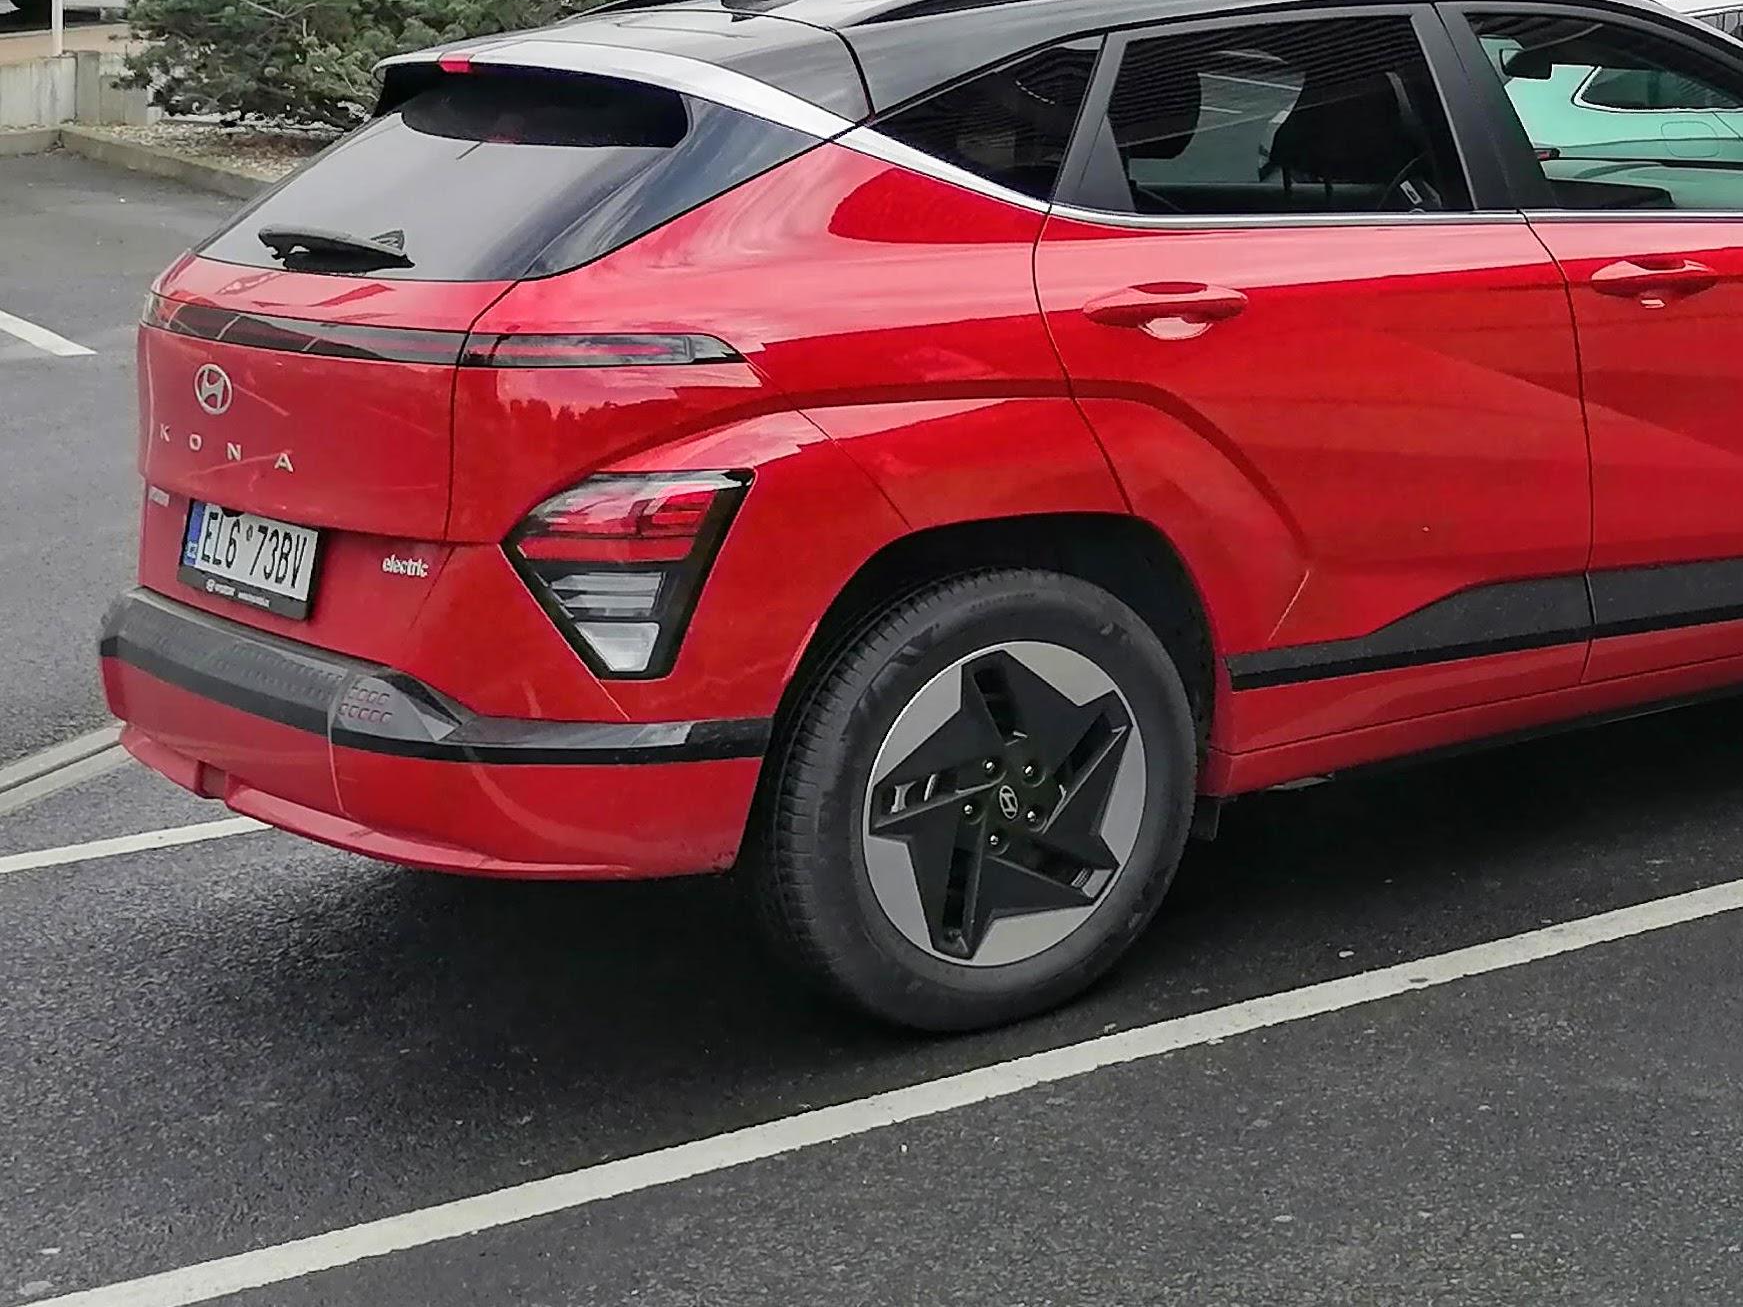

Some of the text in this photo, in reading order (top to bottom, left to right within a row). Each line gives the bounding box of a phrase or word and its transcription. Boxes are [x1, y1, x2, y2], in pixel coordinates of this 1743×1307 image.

[159, 424, 294, 473] KONA
[201, 511, 308, 589] EL6 73BV
[382, 554, 429, 577] electric
